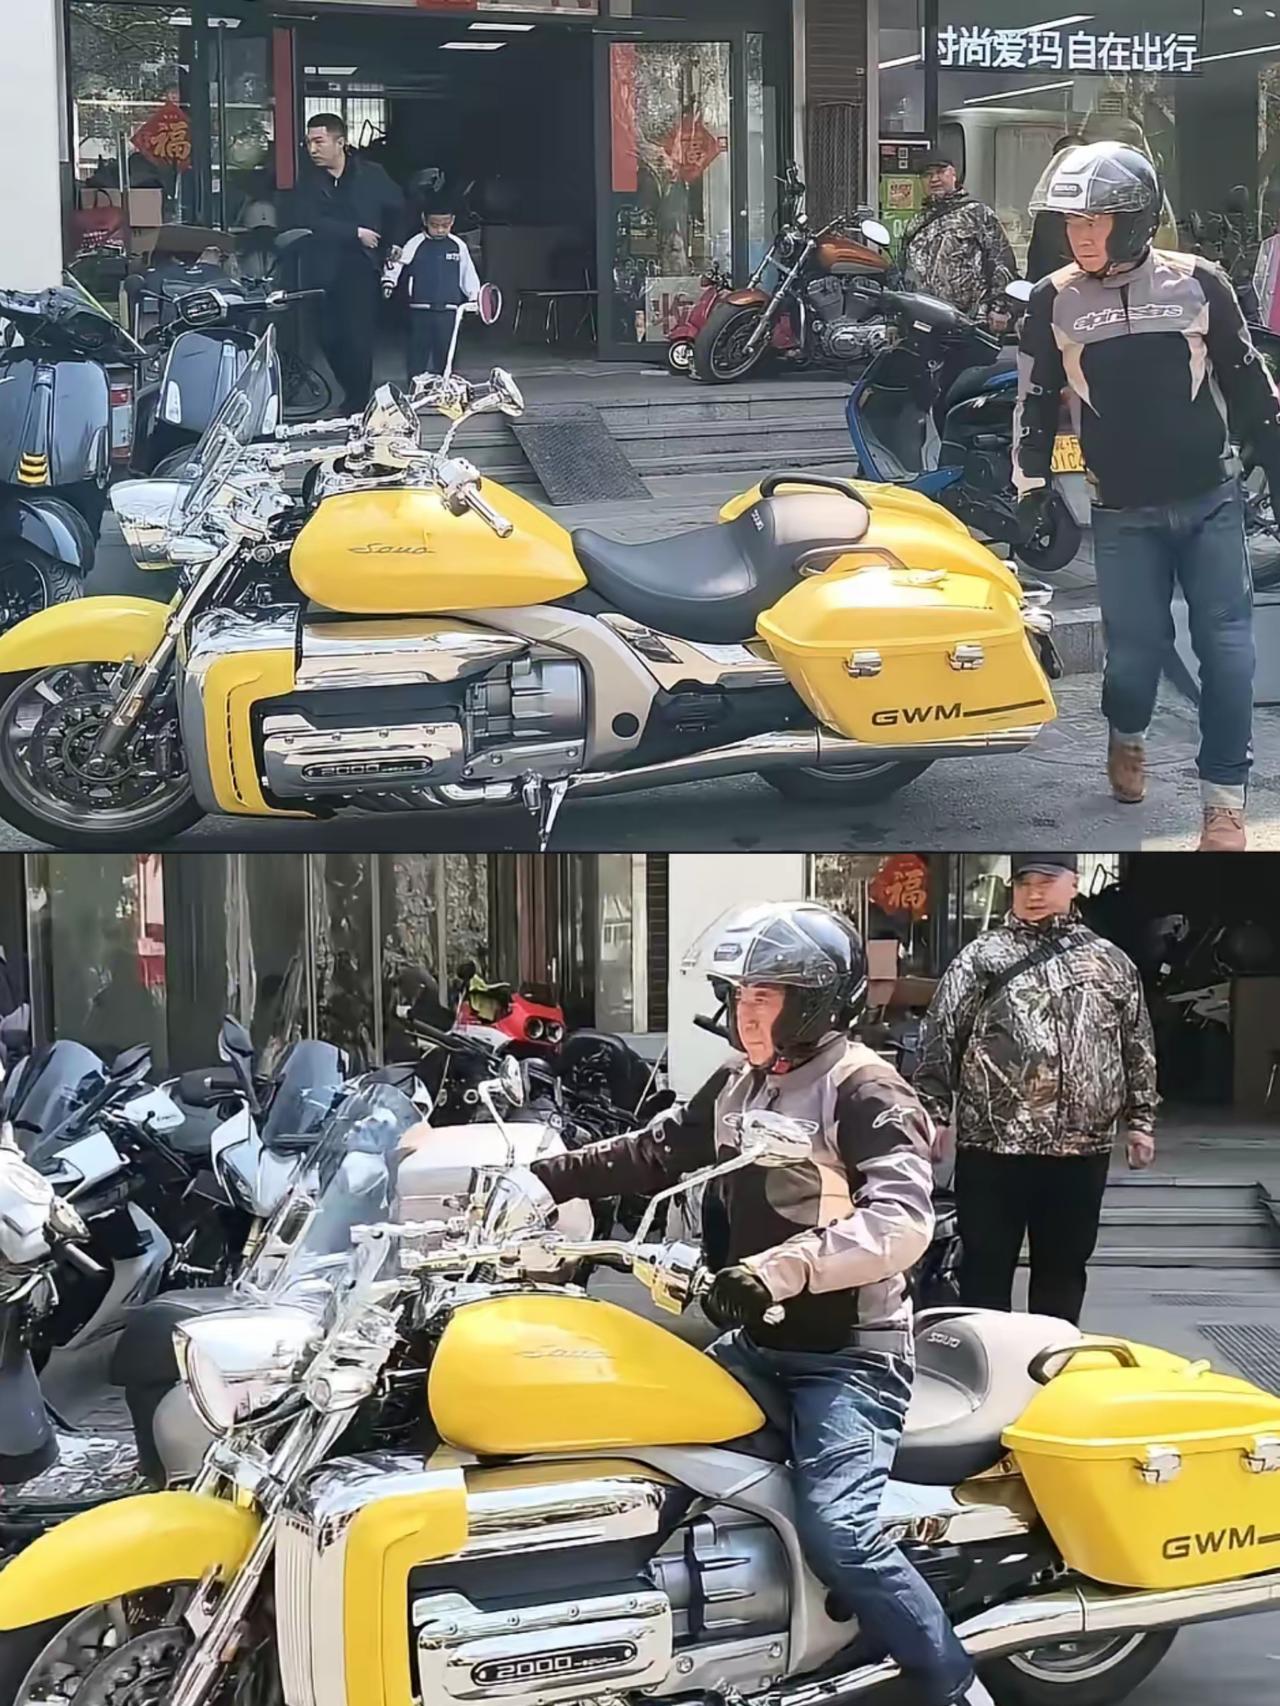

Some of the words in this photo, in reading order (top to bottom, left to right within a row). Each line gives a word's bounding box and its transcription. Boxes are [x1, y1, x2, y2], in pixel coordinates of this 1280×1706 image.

[151, 121, 191, 160] 福
[871, 702, 962, 726] GWM
[320, 764, 380, 777] 2000
[884, 869, 927, 908] 福
[1162, 1524, 1255, 1560] GWM
[496, 1655, 573, 1678] 2000
